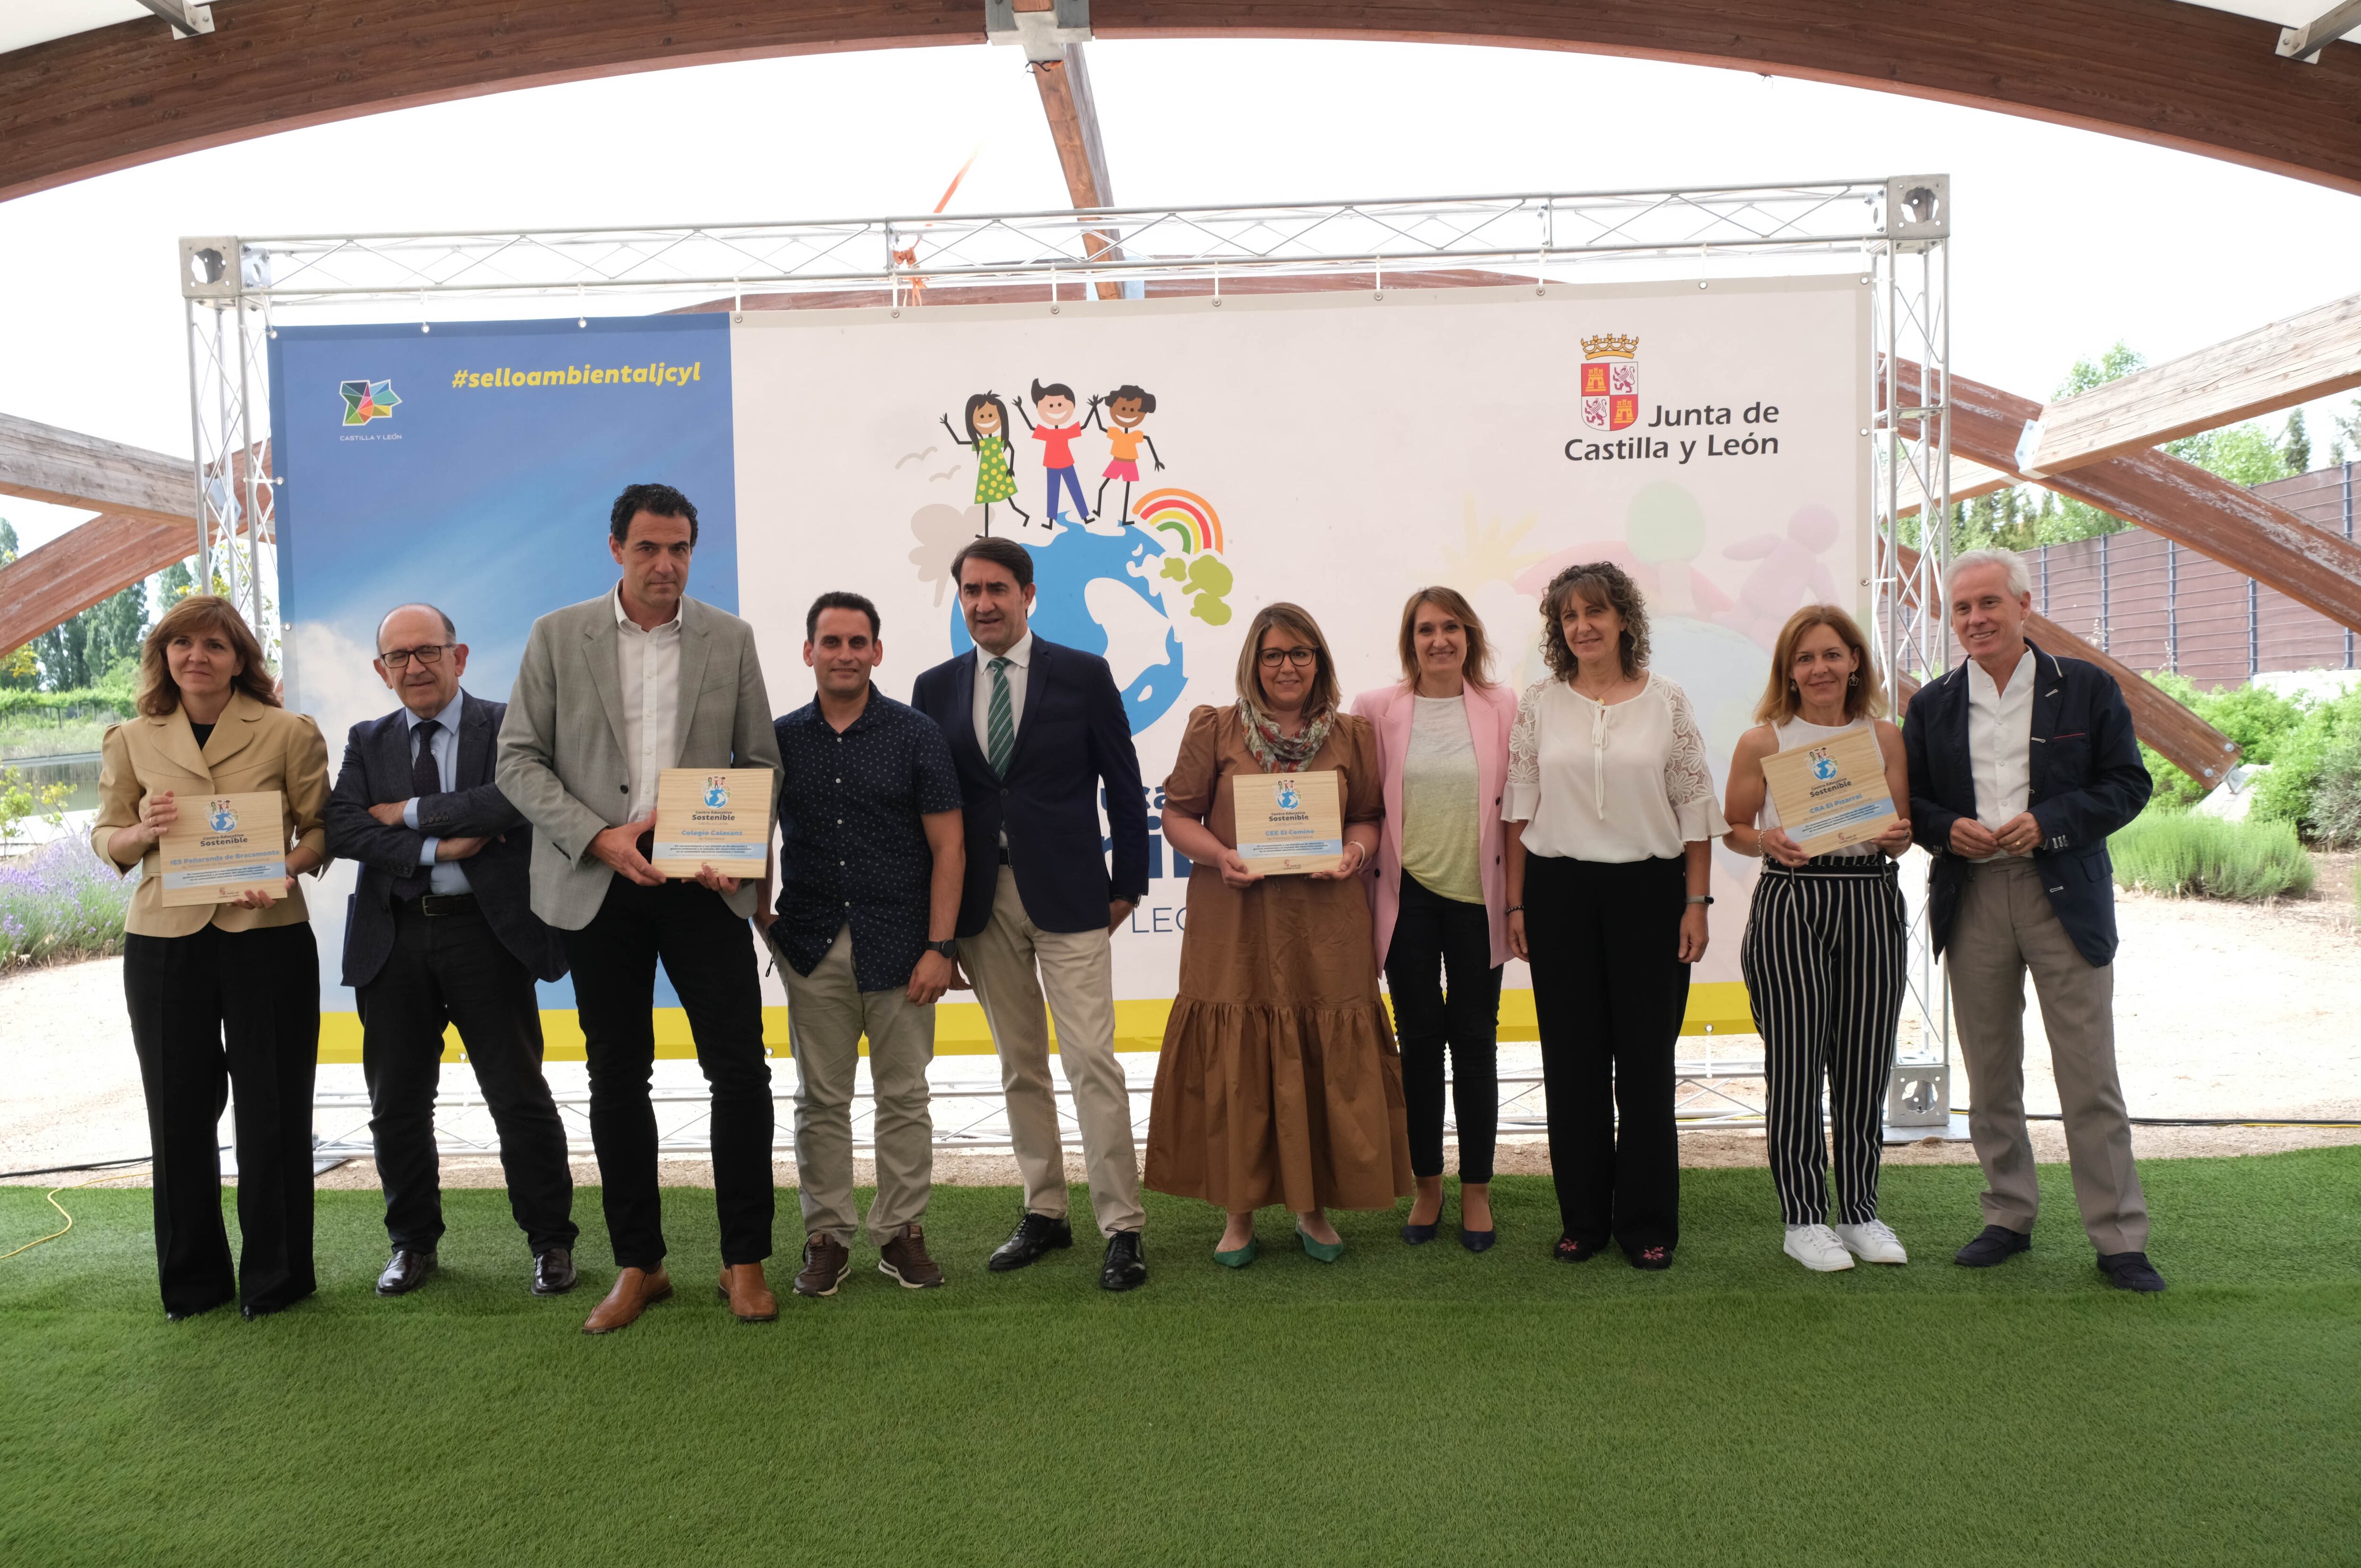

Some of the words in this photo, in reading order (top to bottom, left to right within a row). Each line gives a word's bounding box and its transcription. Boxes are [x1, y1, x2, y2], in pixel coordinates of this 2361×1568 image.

[452, 362, 701, 388] #selloambientaljcyl
[1648, 405, 1731, 427] Junta
[1743, 401, 1779, 424] de
[1564, 437, 1669, 461] Castilla
[1679, 440, 1697, 465] y
[1708, 432, 1779, 456] León
[1810, 781, 1851, 797] Sostenible
[1810, 805, 1825, 814] CRA
[1834, 793, 1862, 806] Pizarral
[200, 837, 248, 847] Sostenible
[184, 856, 223, 864] Peñaranda
[236, 850, 280, 859] Bracamonte
